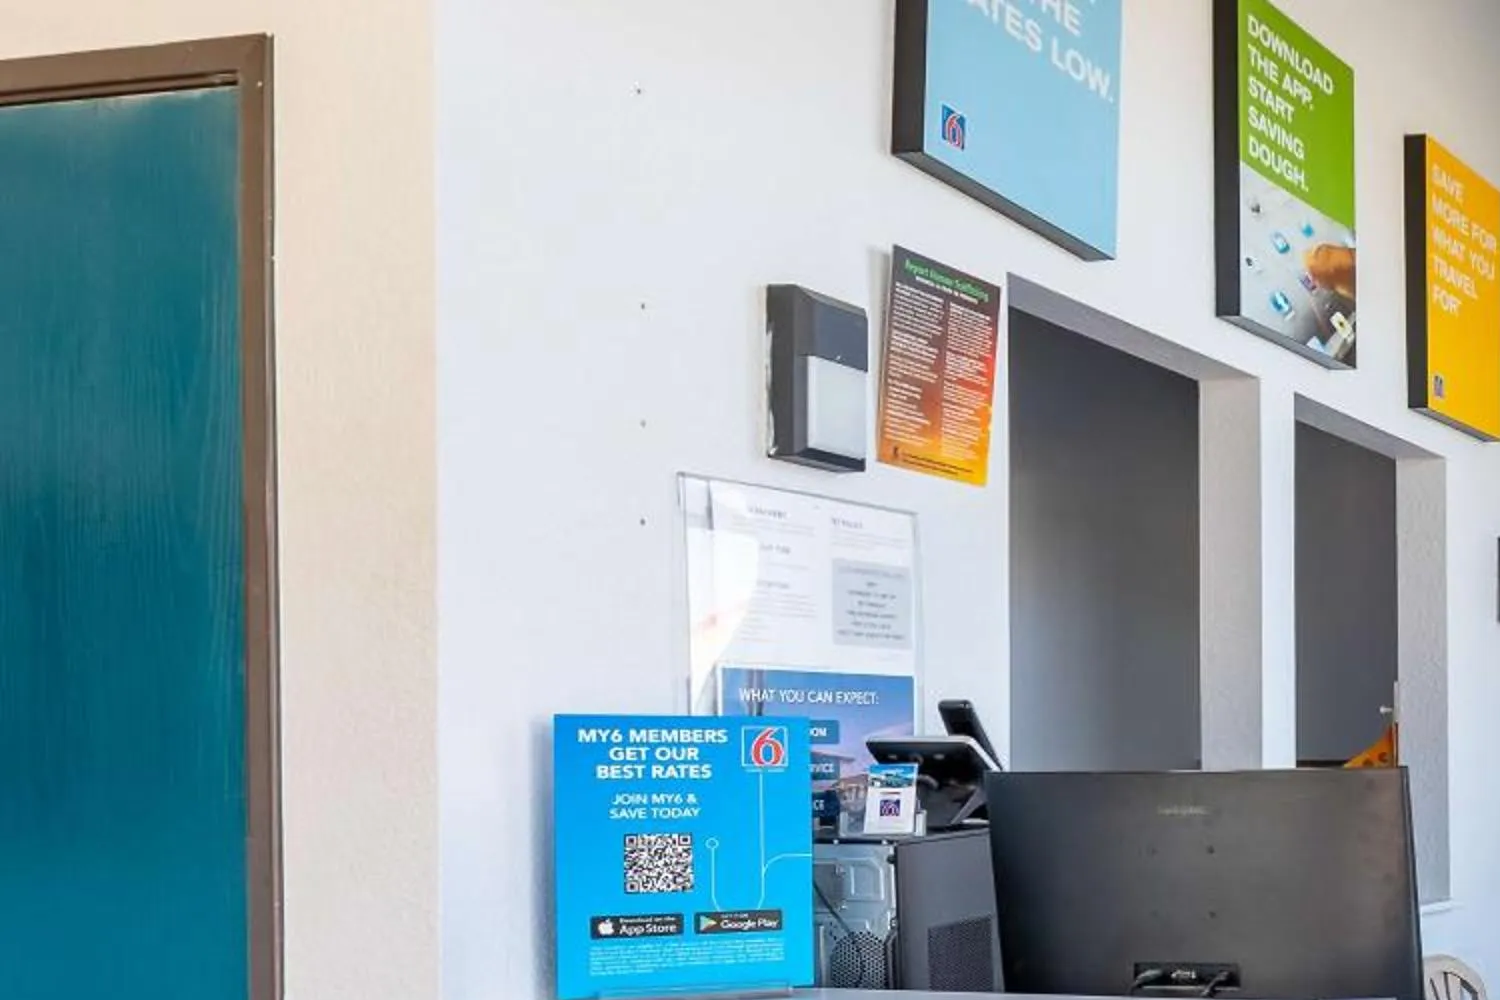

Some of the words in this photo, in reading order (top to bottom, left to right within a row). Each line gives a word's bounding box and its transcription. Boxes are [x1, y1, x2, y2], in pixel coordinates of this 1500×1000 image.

[1029, 0, 1082, 37] HE
[965, 0, 1043, 51] TES
[1051, 37, 1114, 104] LOW.
[1247, 13, 1335, 96] DOWNLOAD
[1247, 43, 1279, 85] THE
[1282, 72, 1313, 111] APP.
[1248, 75, 1295, 123] START
[1248, 105, 1305, 160] SAVING
[1249, 135, 1309, 192] DOUGH.
[1432, 163, 1464, 205] SAVE
[1432, 192, 1470, 237] MORE
[1471, 221, 1498, 255] FOR
[1432, 225, 1466, 262] WHAT
[1469, 249, 1496, 281] YOU
[1432, 255, 1478, 300] TRAVEL
[738, 687, 775, 703] WHAT
[779, 690, 805, 704] YOU
[807, 690, 834, 704] CAN
[835, 691, 880, 706] EXPECT:
[577, 728, 623, 744] MY6
[629, 728, 729, 744] MEMBERS
[609, 747, 650, 762] GET
[655, 747, 700, 762] OUR
[751, 727, 785, 767] 6
[596, 765, 647, 780] BEST
[651, 764, 712, 780] RATES
[609, 808, 647, 820] SAVE
[651, 806, 702, 820] TODAY
[612, 794, 648, 806] JOIN
[652, 793, 683, 805] MY6
[686, 794, 698, 805] &
[619, 924, 645, 937] App
[646, 922, 678, 934] Store
[720, 919, 756, 931] Google
[757, 917, 780, 929] Play
